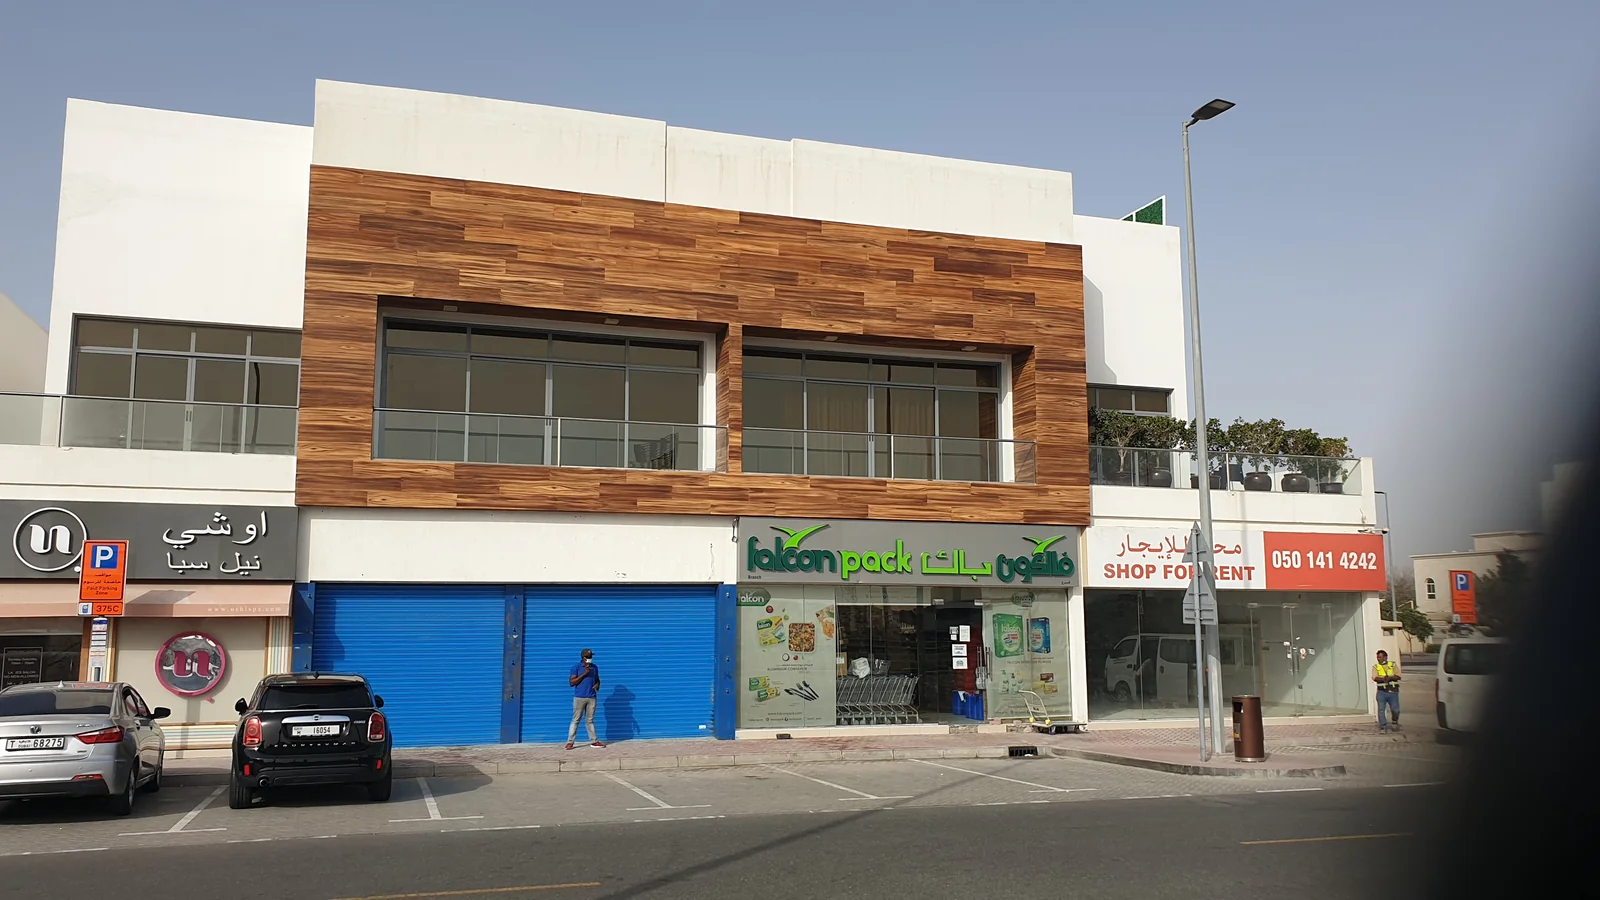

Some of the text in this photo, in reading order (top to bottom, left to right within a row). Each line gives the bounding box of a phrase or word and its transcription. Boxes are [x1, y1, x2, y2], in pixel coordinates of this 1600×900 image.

[95, 545, 114, 568] P
[1213, 542, 1242, 555] مح
[166, 551, 262, 576] نيل سبا
[747, 535, 912, 580] falcon pack
[920, 549, 1075, 583] فالكون باك
[1271, 550, 1377, 570] 050 141 4242
[1103, 563, 1157, 580] SHOP
[1456, 573, 1467, 590] P
[96, 604, 120, 613] 375C
[313, 726, 331, 734] 16054
[33, 738, 63, 748] 68275
